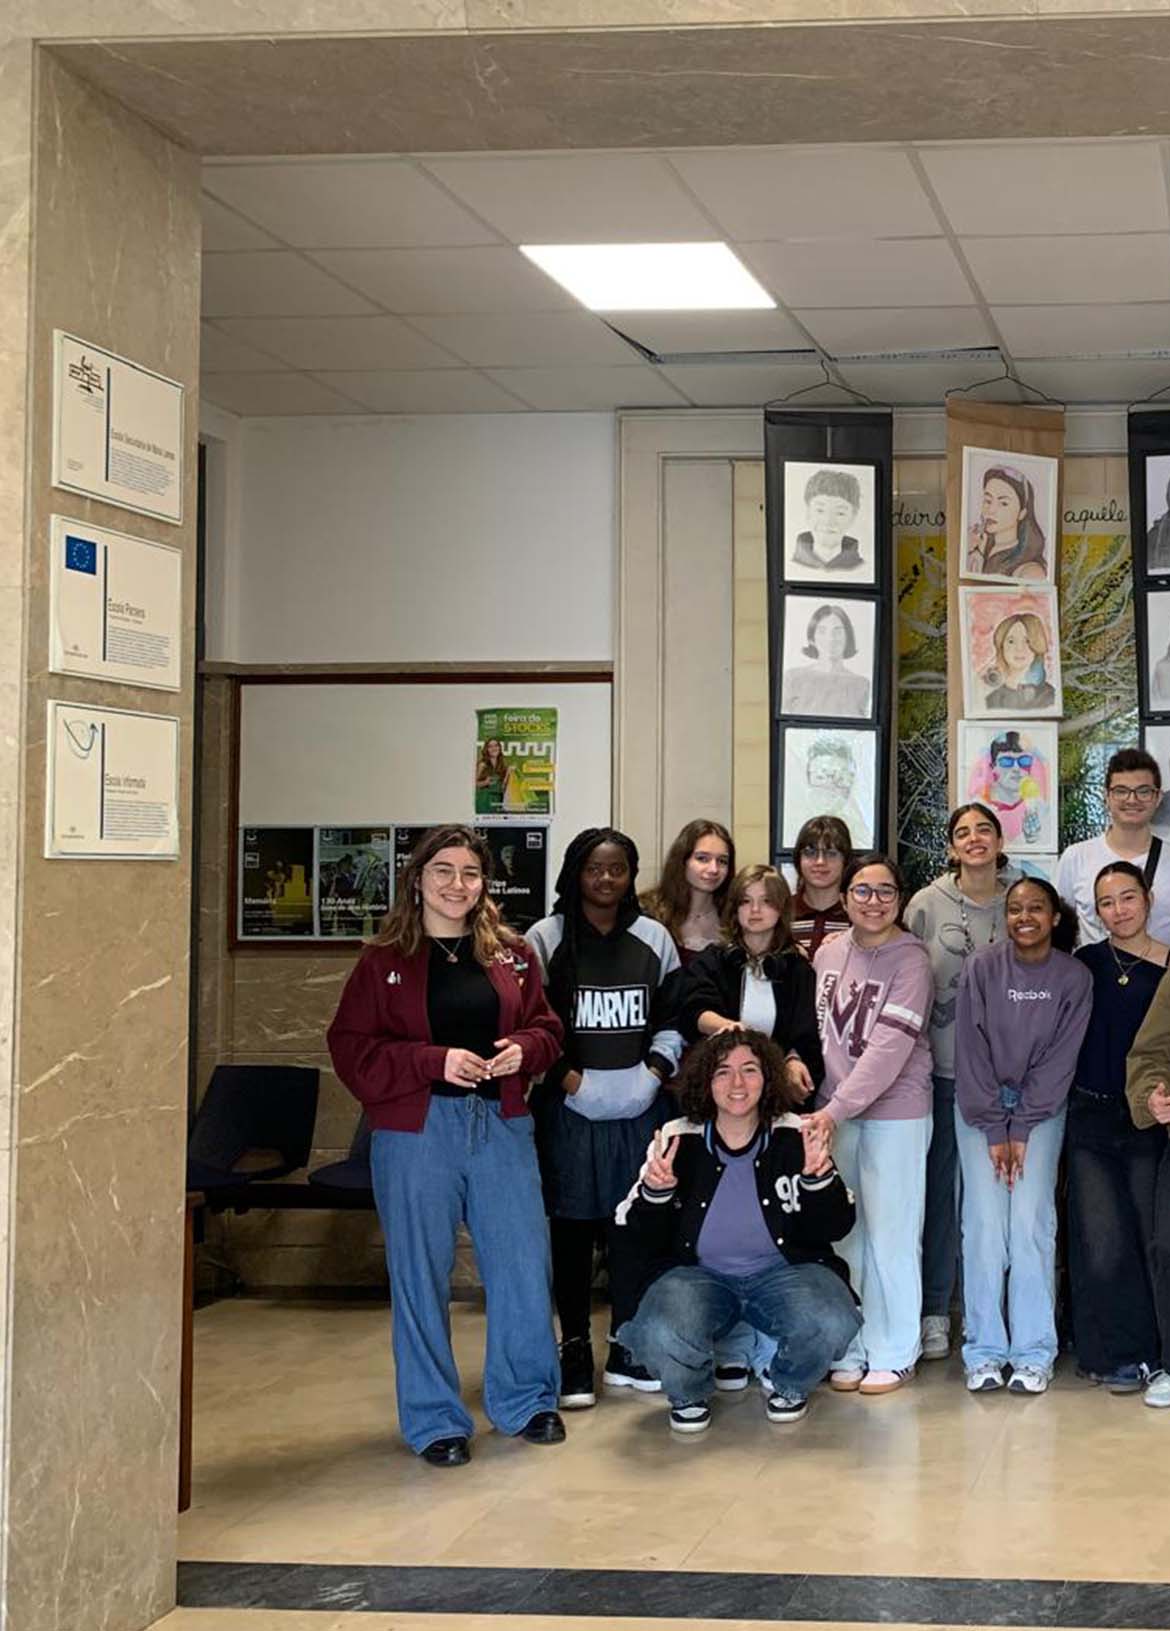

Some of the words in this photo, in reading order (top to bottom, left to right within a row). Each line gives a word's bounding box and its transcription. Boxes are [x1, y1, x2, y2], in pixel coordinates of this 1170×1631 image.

[891, 502, 946, 527] deiro
[1008, 989, 1052, 1002] Reebok
[575, 989, 647, 1029] MARVEL
